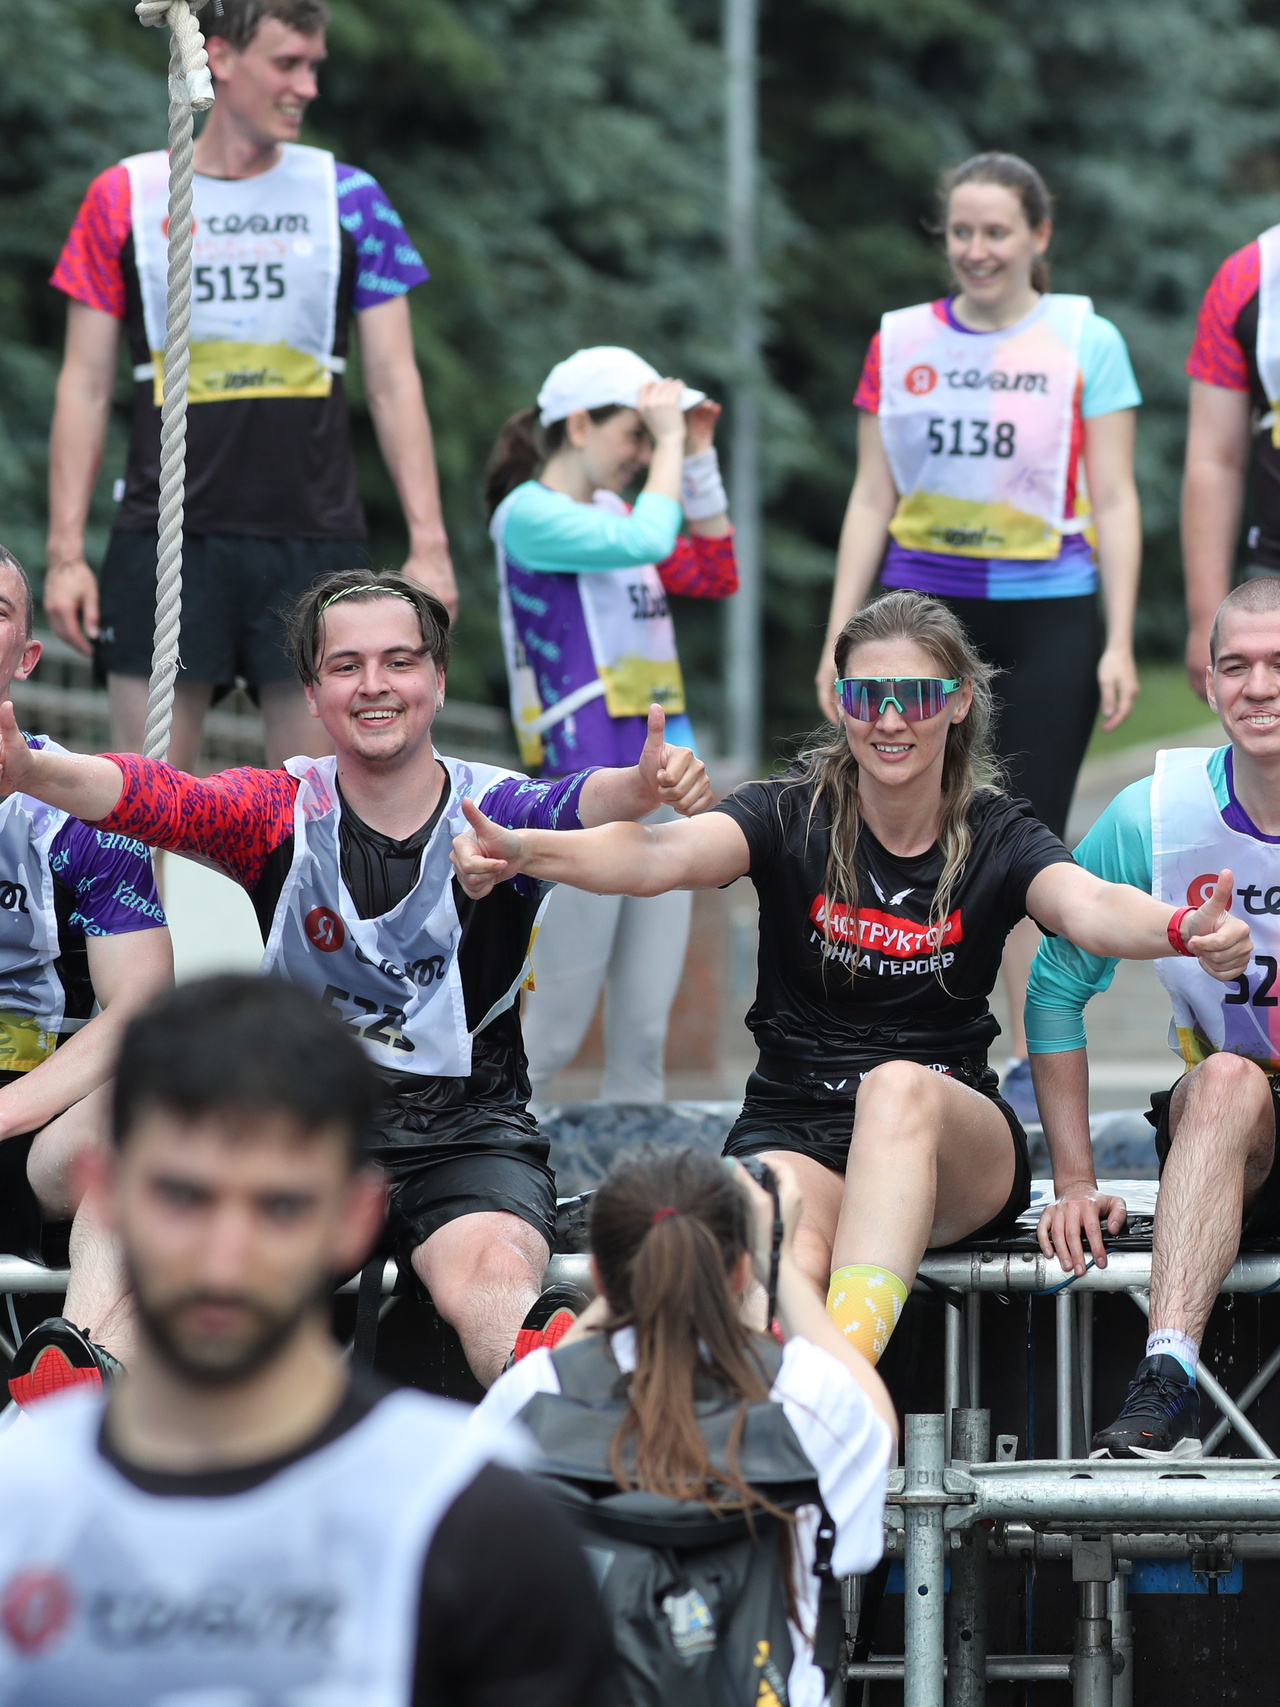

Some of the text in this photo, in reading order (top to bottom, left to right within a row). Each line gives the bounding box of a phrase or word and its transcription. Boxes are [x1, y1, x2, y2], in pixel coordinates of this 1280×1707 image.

[194, 263, 287, 303] 5135
[945, 368, 1049, 395] team
[927, 418, 1016, 458] 5138
[313, 916, 335, 946] Я
[815, 904, 953, 953] ИНСТРУКТОР
[809, 930, 956, 976] ГОНКА ГЕРОЕВ
